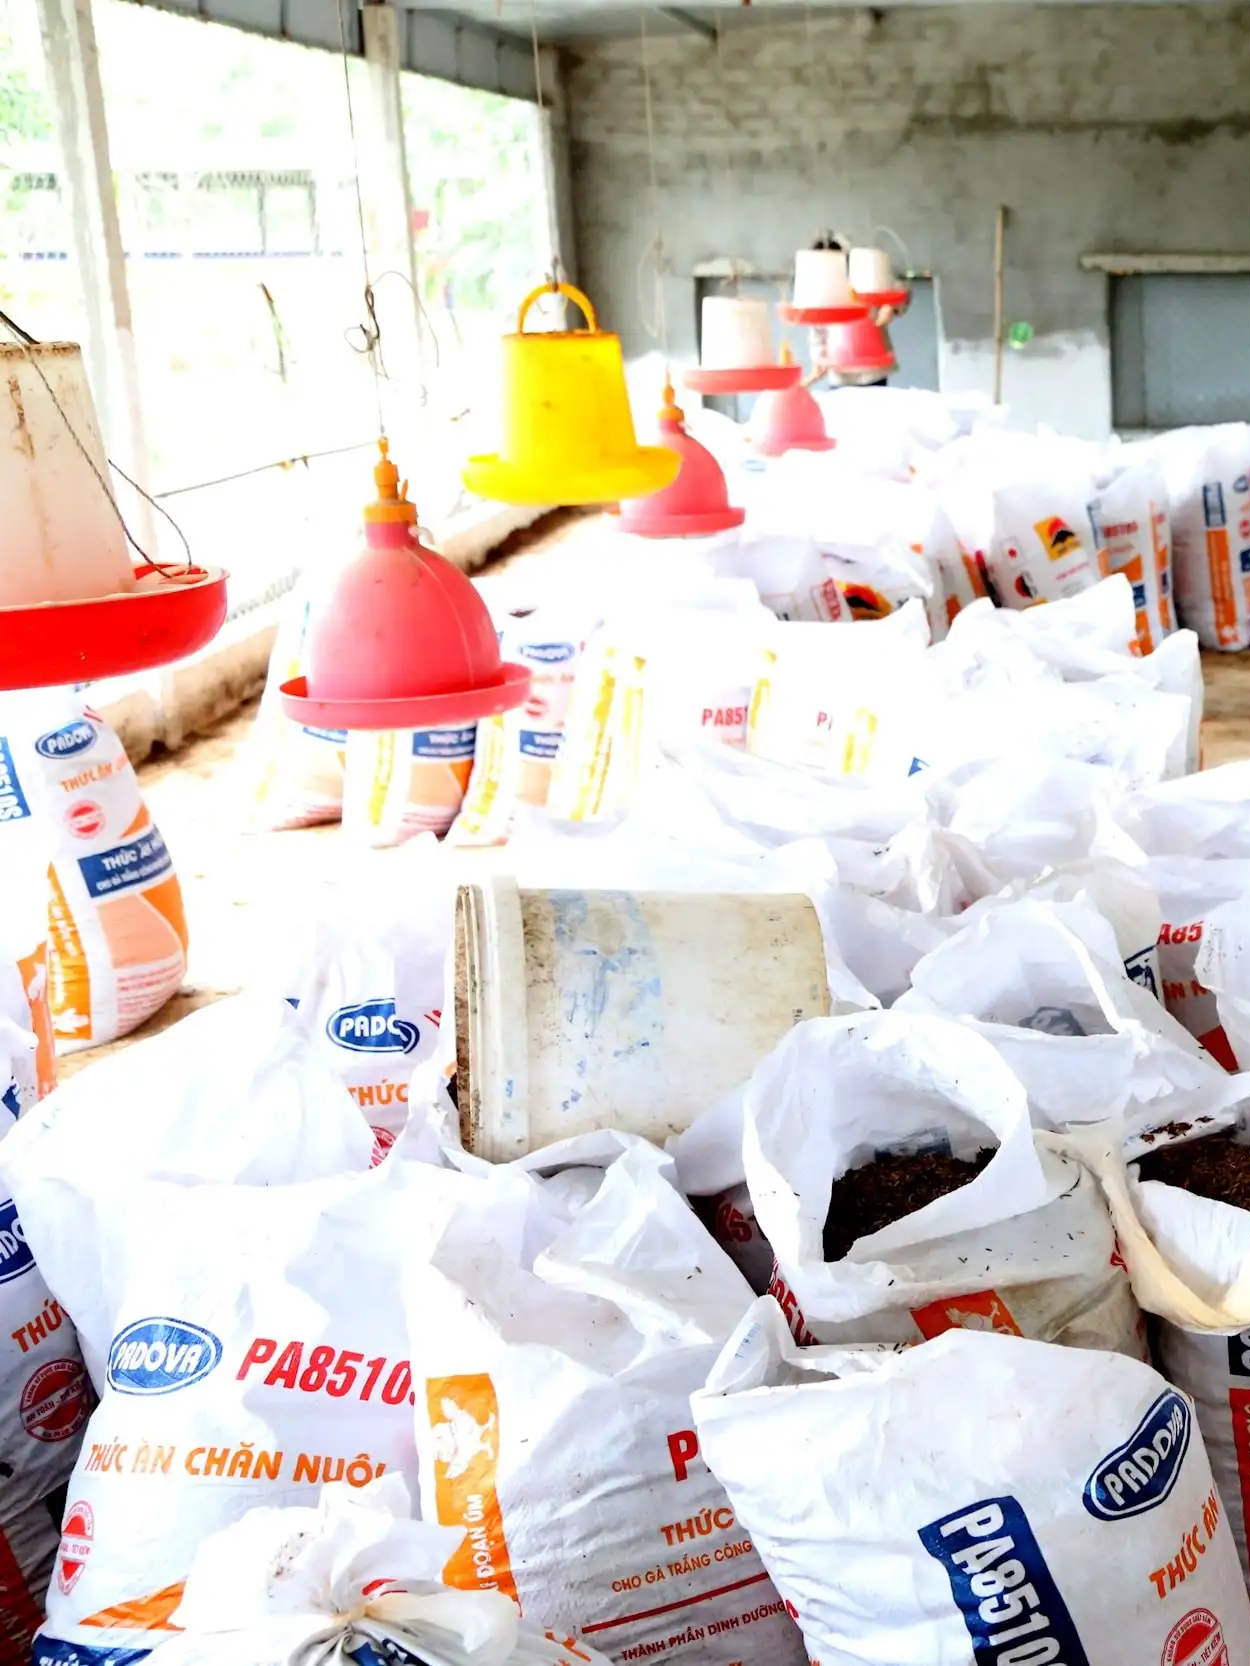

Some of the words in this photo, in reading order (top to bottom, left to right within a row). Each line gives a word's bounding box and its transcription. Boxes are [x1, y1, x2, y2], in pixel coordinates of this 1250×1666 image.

[12, 1299, 69, 1353] THỨ
[113, 1341, 202, 1373] PADOVA
[235, 1338, 415, 1406] PA8510
[85, 1435, 128, 1473] THỨC
[185, 1441, 283, 1481] CHĂN
[1104, 1404, 1183, 1506] PADOVA
[463, 1494, 484, 1523] ÚM
[661, 1507, 735, 1546] THỨC
[612, 1575, 642, 1593] CHO
[645, 1564, 666, 1584] GÀ
[667, 1553, 711, 1577] TRẮNG
[714, 1540, 753, 1562] CÔNG
[940, 1503, 1069, 1666] PA8510
[1149, 1524, 1206, 1600] THỨC
[621, 1641, 666, 1661] THÀNH
[668, 1626, 705, 1648] PHẦN
[707, 1616, 740, 1636] DINH
[742, 1599, 787, 1624] DƯỠNG
